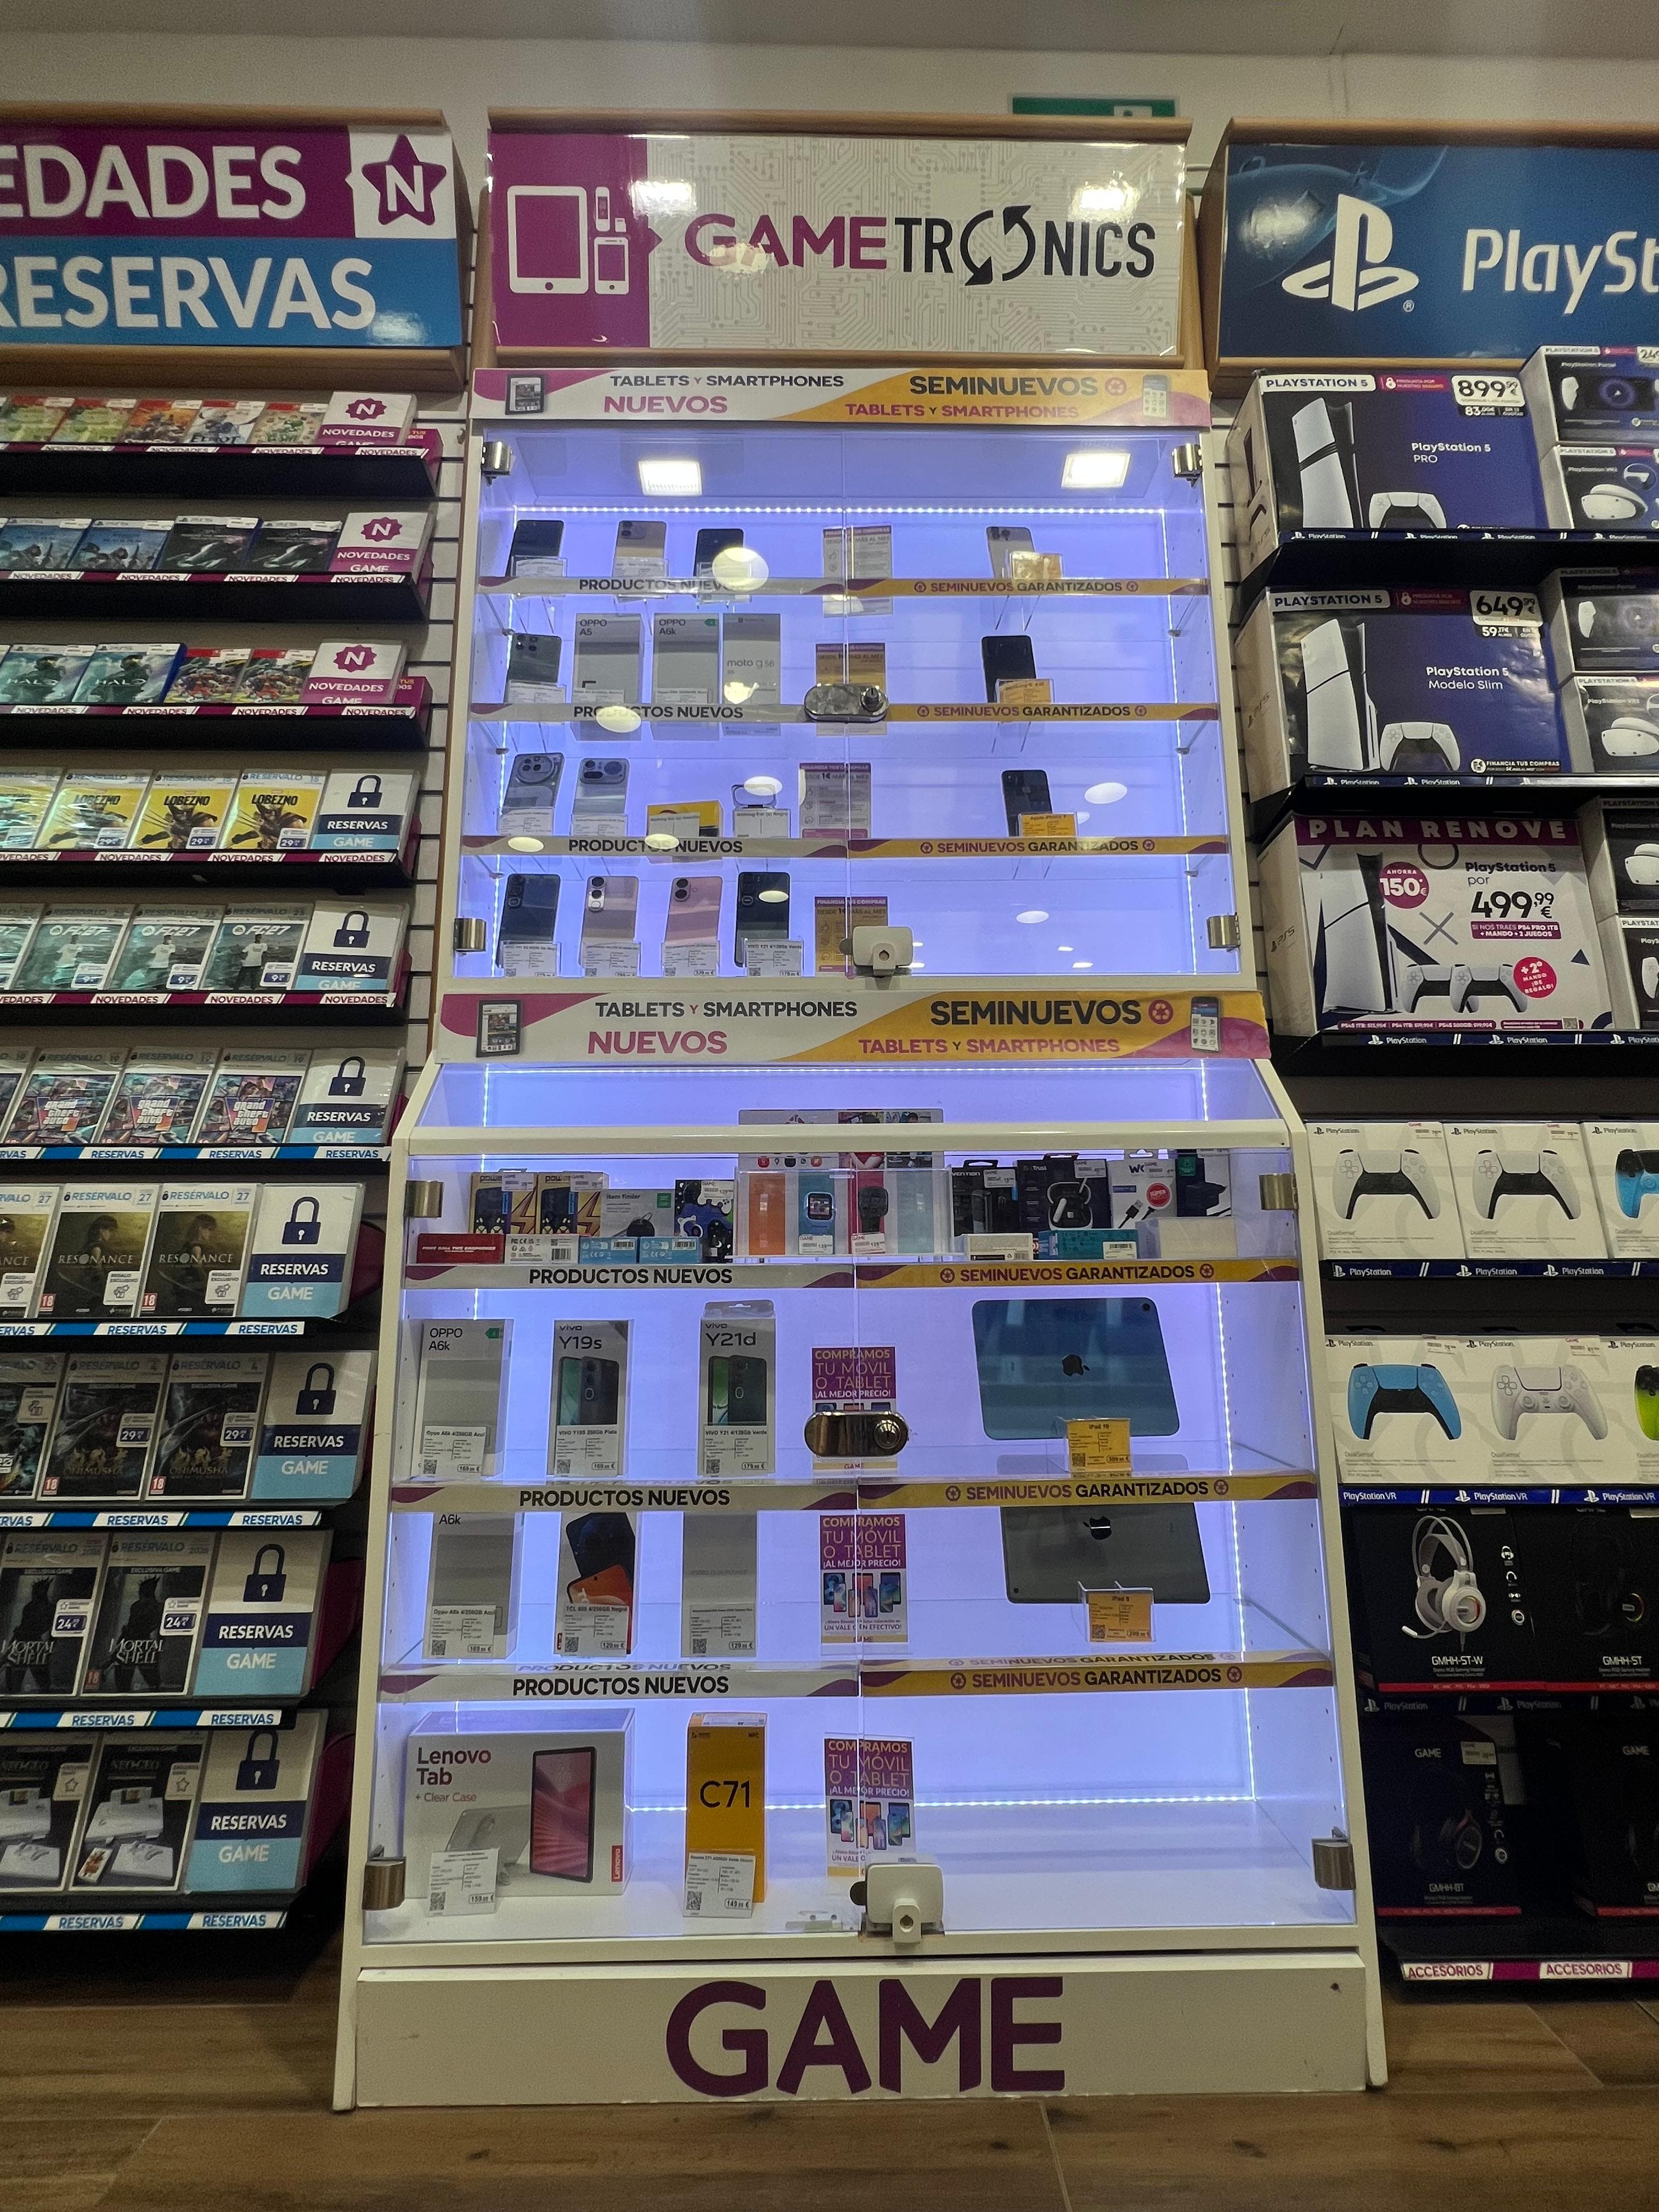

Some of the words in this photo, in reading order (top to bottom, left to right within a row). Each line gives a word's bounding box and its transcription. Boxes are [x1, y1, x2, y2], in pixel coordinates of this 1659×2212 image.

[386, 165, 426, 212] N
[0, 256, 375, 330] ESERVAS
[610, 375, 691, 388] TABLETS
[706, 374, 844, 387] SMARTPHONES
[910, 376, 1097, 396] SEMINUEVOS
[1266, 379, 1357, 388] PLAYSTATION
[1360, 378, 1368, 387] 5
[603, 395, 728, 414] NUEVOS
[844, 403, 925, 418] TABLETS
[929, 406, 939, 415] Y
[942, 403, 1079, 419] SMARTPHONES
[323, 429, 394, 438] NOVEDADES
[1412, 442, 1481, 453] PlayStation
[1485, 443, 1491, 452] 5
[1414, 454, 1438, 463] PRO
[338, 552, 410, 561] NOVEDADES
[579, 579, 676, 590] PRODUCTOS
[930, 583, 1014, 592] SEMINUEVOS
[1017, 582, 1122, 592] GARANTIZADOS
[1274, 595, 1372, 607] PLAYSTATION
[1374, 595, 1383, 603] 5
[580, 619, 607, 627] OPPO
[659, 619, 686, 627] OPPO
[659, 628, 676, 636] A6k
[727, 659, 753, 668] moto
[1426, 667, 1499, 678] PlayStation
[1502, 668, 1509, 677] 5
[309, 682, 384, 692] NOVEDADES
[1429, 679, 1473, 690] Modelo
[1477, 679, 1503, 690] Slim
[346, 708, 407, 716] NOVEDADES
[252, 794, 298, 805] LOBEZNO
[328, 820, 388, 831] RESERVAS
[1309, 820, 1404, 838] PLAN
[1423, 820, 1567, 838] RENOVE
[334, 837, 373, 848] GAME
[676, 840, 742, 853] NUEVOS
[938, 842, 1024, 853] SEMINUEVOS
[1028, 840, 1138, 851] GARANTIZADOS
[1465, 862, 1546, 874] PlayStation
[1549, 864, 1556, 872] 5
[1468, 877, 1489, 886] por
[312, 961, 376, 973] RESERVAS
[325, 995, 387, 1004] NOVEDADES
[595, 1002, 685, 1018] TABLETS
[690, 1005, 699, 1014] Y
[703, 1001, 858, 1018] SMARTPHONES
[930, 1000, 1141, 1027] SEMINUEVOS
[588, 1030, 727, 1054] NUEVOS
[858, 1038, 948, 1053] TABLETS
[953, 1041, 962, 1050] Y
[966, 1037, 1121, 1053] SMARTPHONES
[235, 1101, 266, 1110] grand
[239, 1109, 268, 1119] theft
[307, 1111, 371, 1122] RESERVAS
[233, 1118, 258, 1126] auto
[326, 1149, 379, 1158] RESERVAS
[170, 1190, 229, 1200] RESÉRVALO
[236, 1192, 249, 1200] 27
[260, 1263, 328, 1276] RESERVAS
[960, 1268, 1062, 1282] SEMINUEVOS
[1066, 1266, 1194, 1280] GARANTIZADOS
[1350, 1267, 1392, 1277] PlayStation
[1562, 1267, 1604, 1276] PlayStation
[529, 1269, 648, 1284] PRODUCTOS
[653, 1268, 732, 1283] NUEVOS
[268, 1287, 313, 1301] GAME
[239, 1324, 297, 1334] RESERVAS
[430, 1328, 462, 1339] OPPO
[558, 1336, 602, 1350] Y19s
[705, 1332, 757, 1346] Y21d
[428, 1340, 450, 1351] A6k
[274, 1436, 343, 1448] RESERVAS
[281, 1460, 328, 1475] GAME
[967, 1485, 1072, 1500] SEMINUEVOS
[1075, 1481, 1209, 1497] GARANTIZADOS
[1344, 1492, 1384, 1500] PlayStation
[1603, 1492, 1643, 1501] PlayStation
[520, 1491, 644, 1506] PRODUCTOS
[648, 1490, 730, 1505] NUEVOS
[242, 1514, 302, 1526] RESERVAS
[439, 1514, 461, 1526] A6k
[823, 1517, 900, 1528] COMPRAMOS
[823, 1530, 844, 1544] TU
[855, 1527, 901, 1544] MÓVIL
[823, 1545, 835, 1558] O
[845, 1544, 900, 1558] TABLET
[838, 1559, 866, 1567] MEJOR
[868, 1559, 901, 1567] PRECIO!
[219, 1625, 294, 1639] RESERVAS
[227, 1653, 276, 1669] GAME
[1432, 1656, 1483, 1665] GMHH-ST-W
[1602, 1656, 1642, 1665] GMHH-ST
[973, 1672, 1081, 1687] SEMINUEVOS
[1085, 1669, 1221, 1685] GARANTIZADOS
[513, 1678, 640, 1696] PRODUCTOS
[645, 1677, 729, 1694] NUEVOS
[211, 1713, 274, 1725] RESERVAS
[417, 1748, 491, 1765] Lenovo
[417, 1768, 452, 1786] Tab
[424, 1793, 448, 1802] Clear
[450, 1793, 477, 1802] Case
[699, 1780, 751, 1809] C71
[211, 1815, 286, 1830] RESERVAS
[219, 1846, 268, 1863] GAME
[202, 1915, 266, 1927] RESERVAS
[1408, 1966, 1483, 1977] ACCESORIOS
[665, 1976, 1065, 2097] GAME
